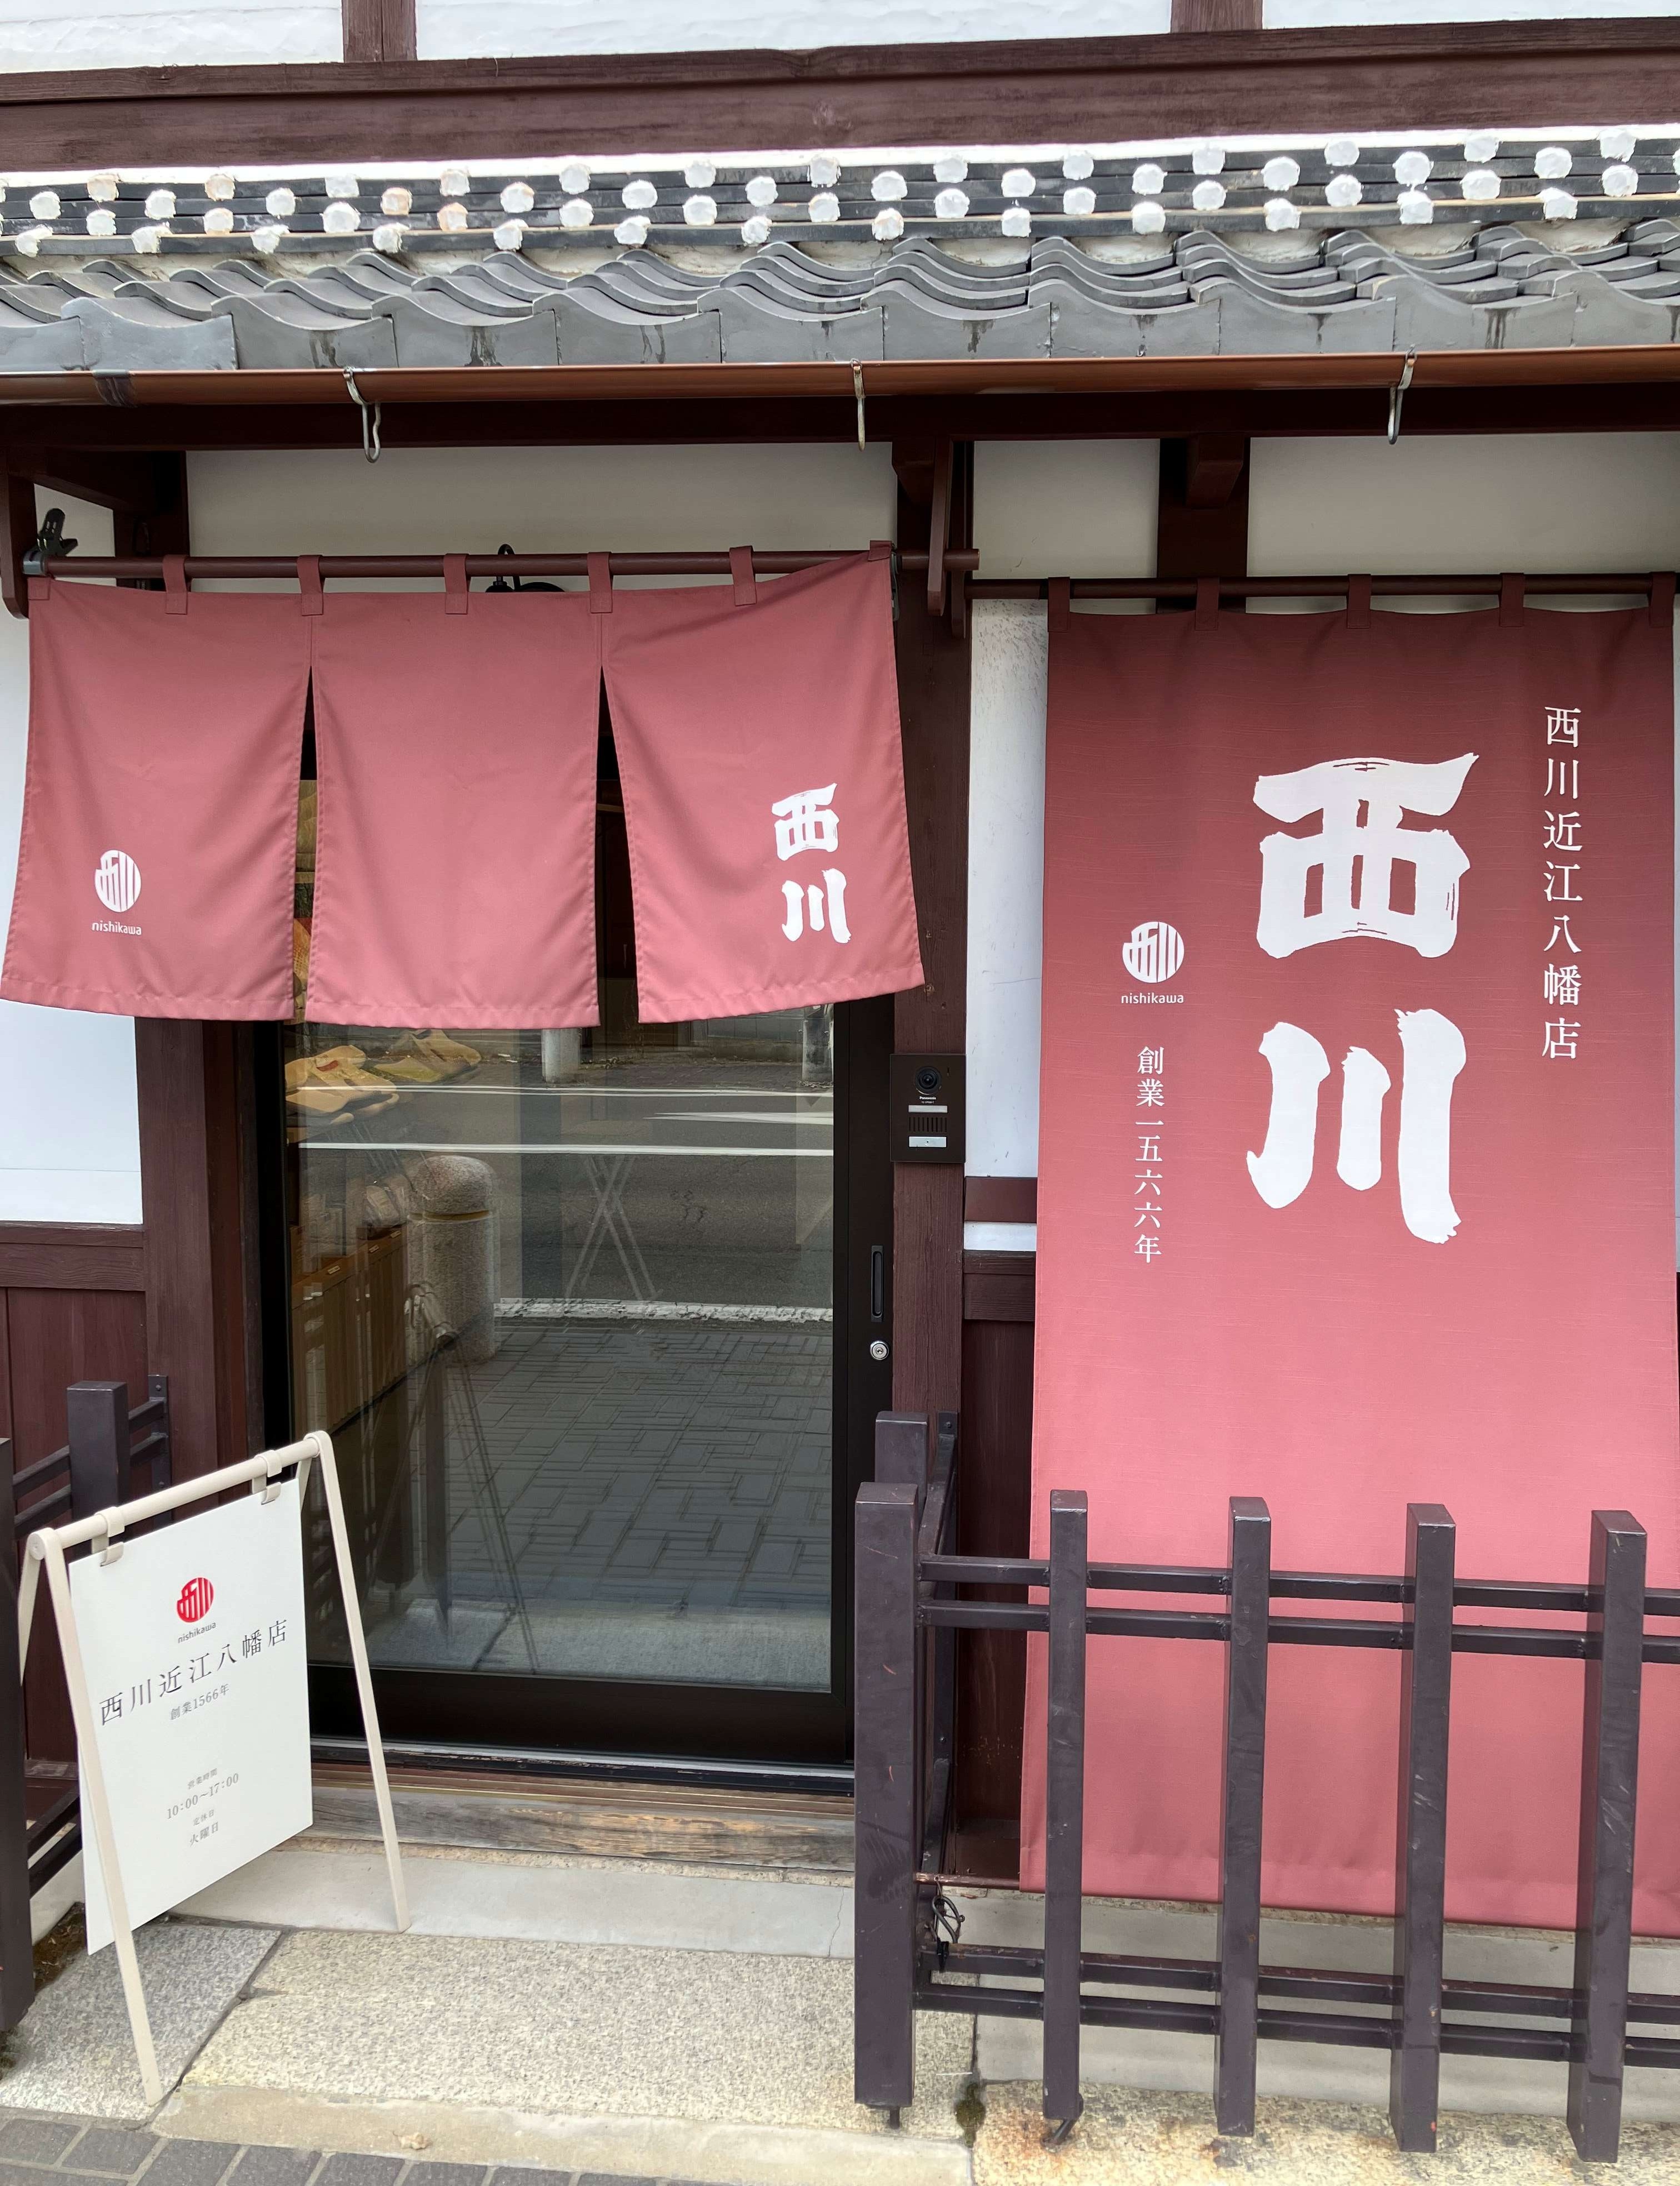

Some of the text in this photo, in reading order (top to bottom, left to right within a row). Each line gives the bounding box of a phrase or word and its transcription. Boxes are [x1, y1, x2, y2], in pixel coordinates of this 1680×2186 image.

[771, 782, 852, 944] 西川
[1542, 706, 1583, 1059] 西川近江八幡店
[92, 920, 142, 936] nishikawa
[1121, 992, 1184, 1004] nishikawa
[1246, 752, 1479, 1244] 西川
[1134, 1046, 1165, 1263] 創業一五六六年
[99, 1619, 287, 1726] 西川近江八幡店
[178, 1622, 216, 1644] nishikawa
[170, 1683, 229, 1721] 創業1566年
